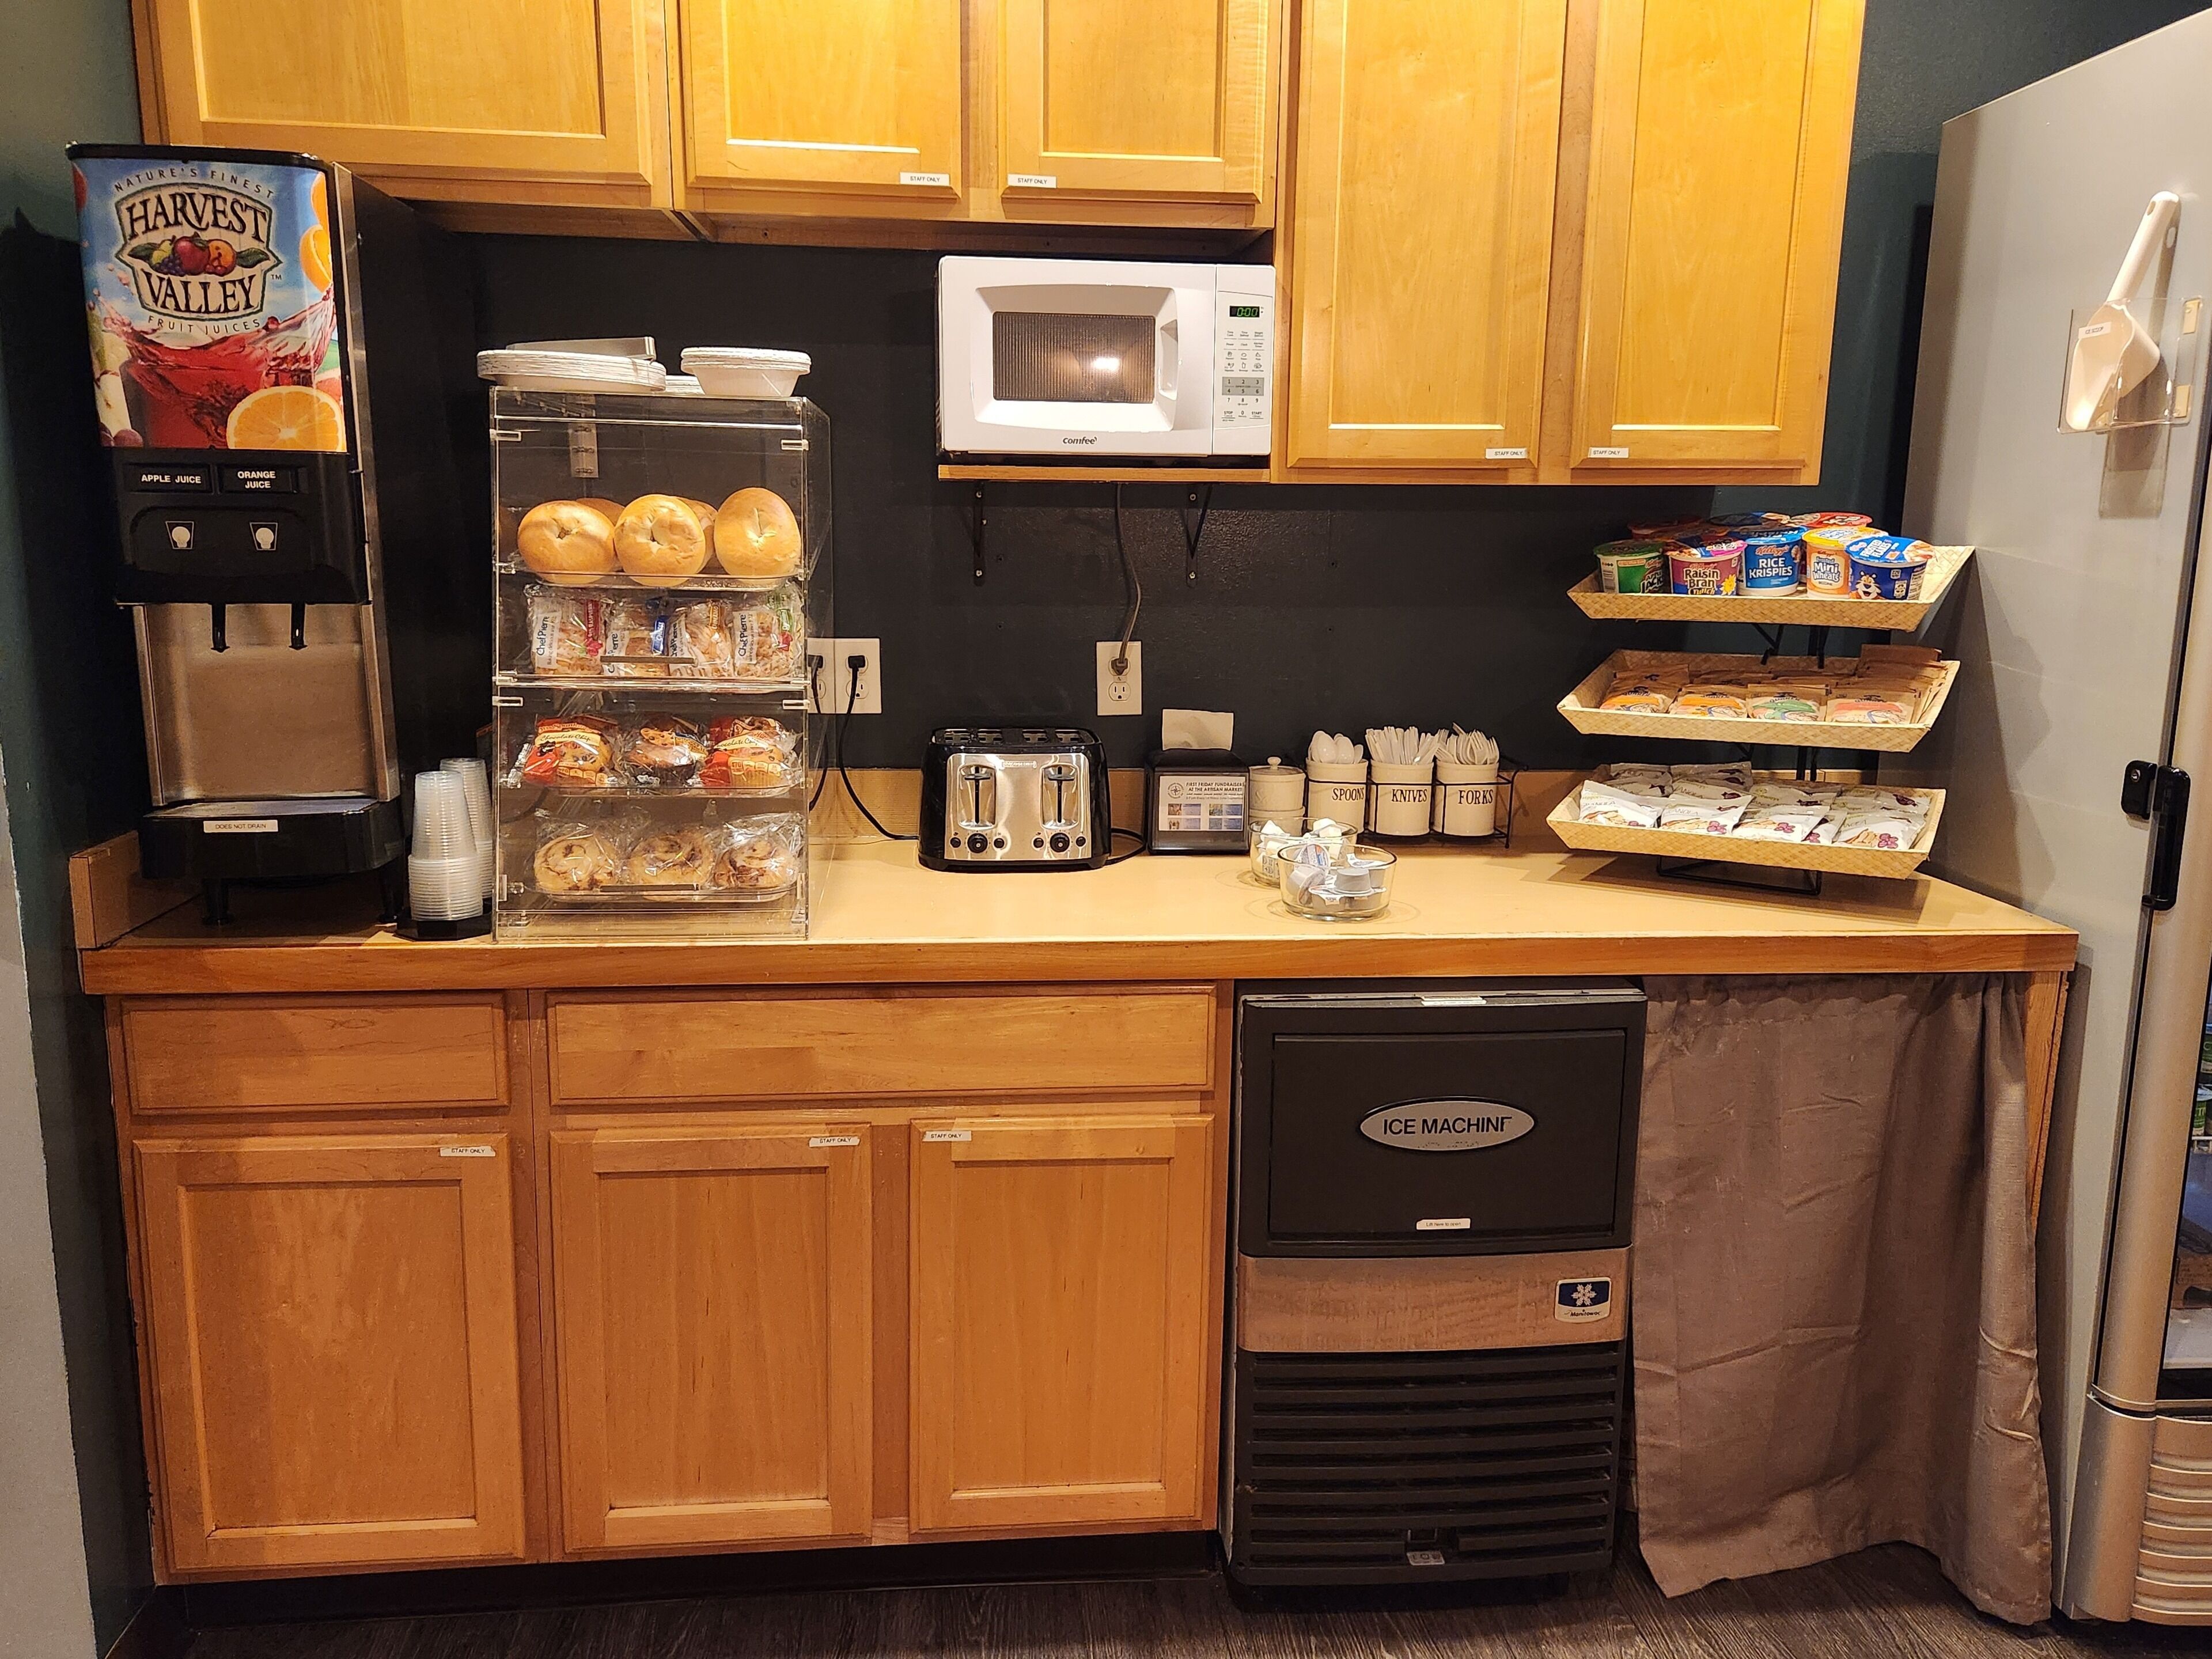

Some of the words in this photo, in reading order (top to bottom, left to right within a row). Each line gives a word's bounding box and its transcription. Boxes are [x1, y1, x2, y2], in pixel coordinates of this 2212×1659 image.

[114, 168, 198, 192] NATURE'S
[210, 171, 274, 198] FINEST
[126, 191, 267, 244] HARVEST
[141, 268, 256, 314] VALLEY
[1237, 307, 1258, 317] 0:00
[148, 315, 194, 332] FRUIT
[205, 319, 260, 335] JUICES
[142, 474, 171, 483] APPLE
[175, 475, 201, 484] JUICE
[237, 471, 276, 479] ORANGE
[245, 480, 271, 488] JUICE
[1759, 557, 1786, 569] RICE
[1813, 562, 1839, 574] Mini
[1684, 568, 1720, 580] Raisin
[1749, 566, 1793, 579] KRISPIES
[1688, 578, 1715, 589] Bran
[540, 733, 574, 742] Chocolate
[717, 740, 744, 748] ocolate
[1332, 787, 1364, 801] SPOONS
[1391, 789, 1427, 802] KNIVES
[1458, 789, 1494, 805] FORKS
[1384, 1119, 1416, 1135] ICE
